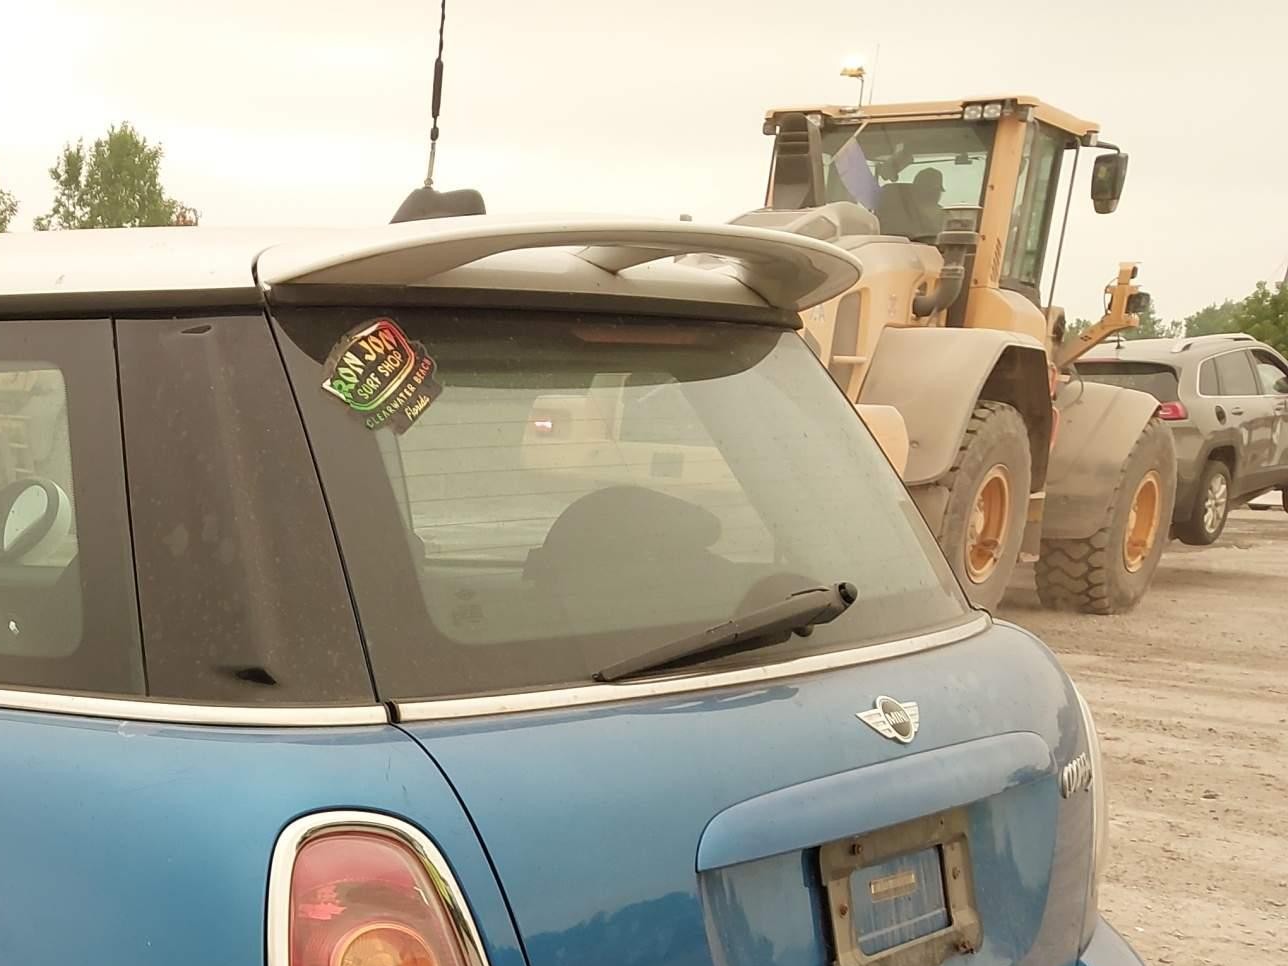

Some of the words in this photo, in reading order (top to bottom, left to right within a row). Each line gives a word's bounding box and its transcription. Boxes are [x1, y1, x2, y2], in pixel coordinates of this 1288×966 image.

[332, 351, 367, 399] RON
[358, 328, 398, 361] JON
[357, 372, 382, 400] SURF
[377, 350, 404, 377] SHOP
[366, 383, 417, 428] CLEARWATER
[413, 356, 432, 384] BEACH
[404, 394, 430, 421] Florida
